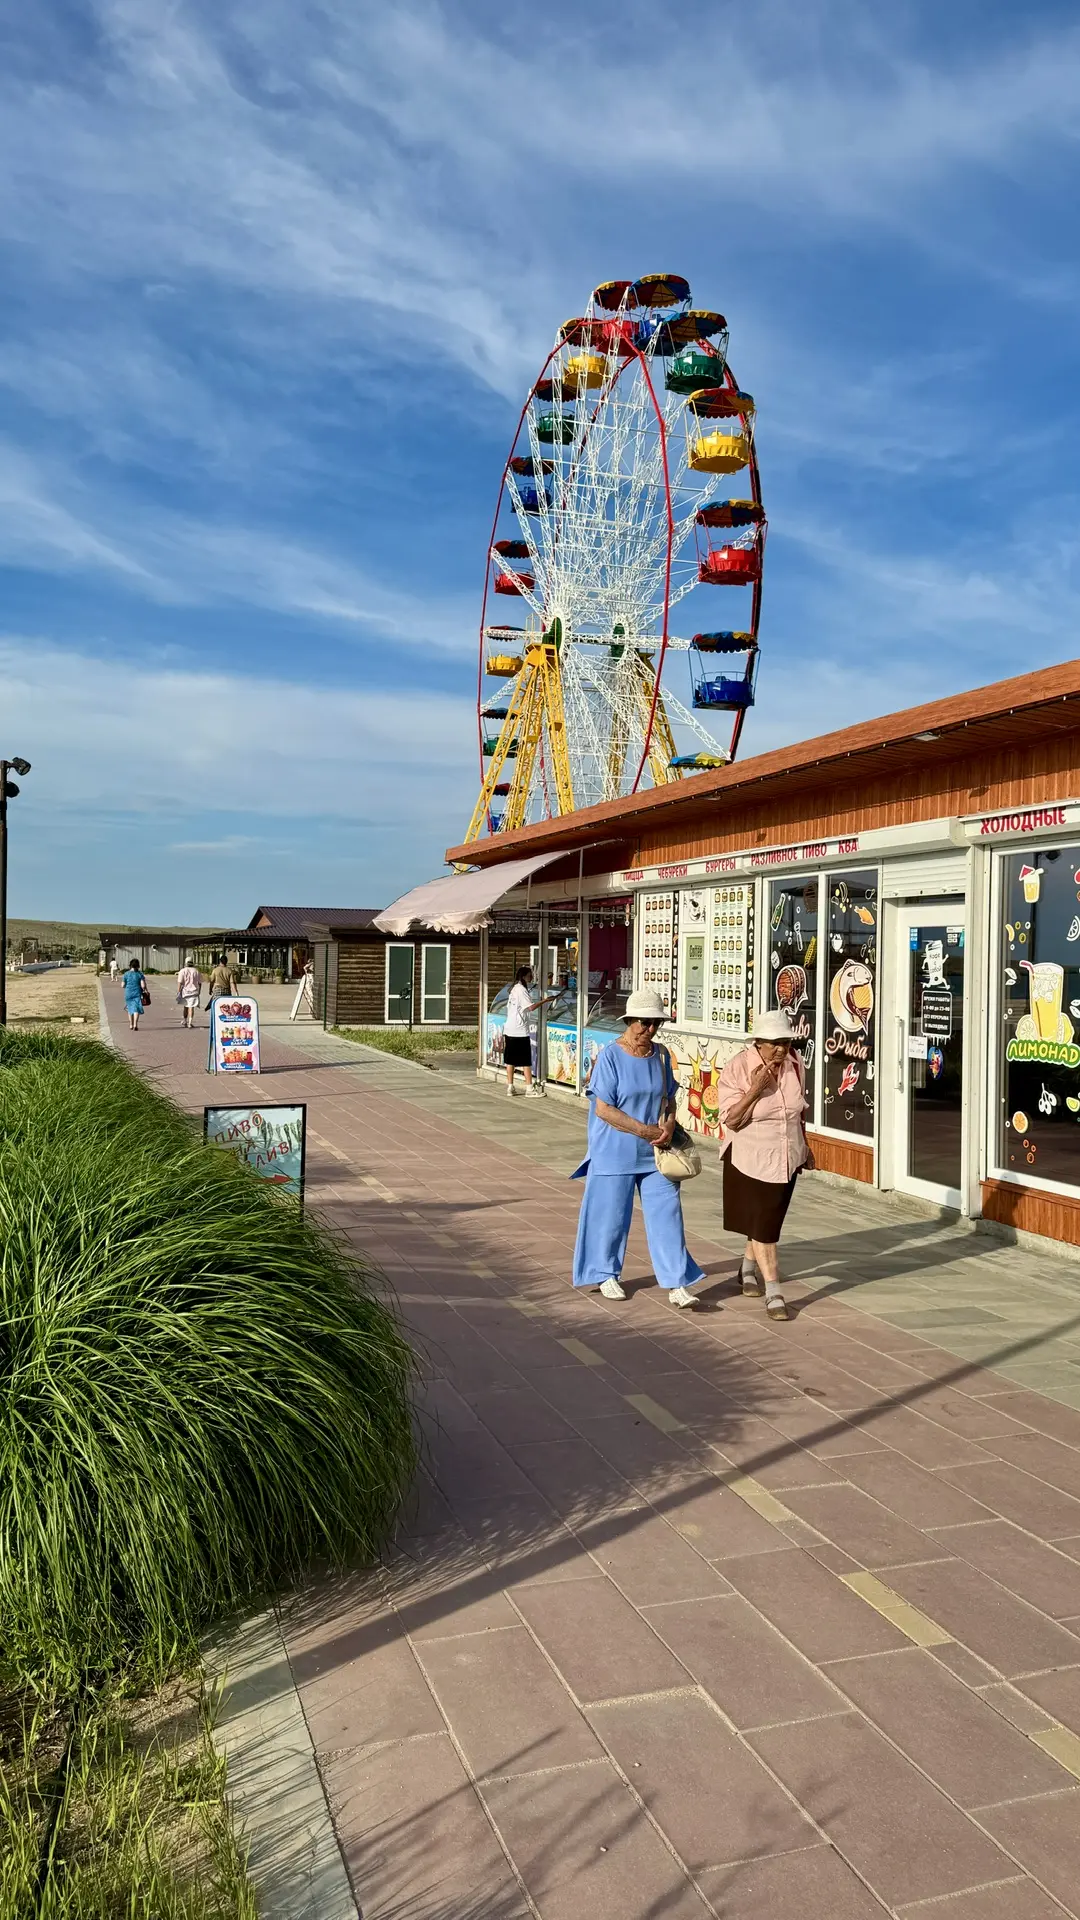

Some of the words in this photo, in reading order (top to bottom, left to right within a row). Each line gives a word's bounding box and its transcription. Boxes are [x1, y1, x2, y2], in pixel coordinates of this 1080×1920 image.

[980, 807, 1067, 835] ХОЛОДНЫЕ
[750, 846, 798, 866] РАЗЛИВНОЕ
[802, 843, 827, 859] ПИВО
[838, 838, 860, 854] КВА
[624, 870, 644, 882] ПИЦЦА
[658, 865, 688, 880] ЧЕБУРЕКИ
[706, 858, 736, 873] БУРГЕРЫ
[787, 1014, 811, 1040] иво
[825, 1027, 868, 1060] Рыба
[1007, 1041, 1079, 1063] ЛИМОНАД
[214, 1113, 263, 1143] ПИВО
